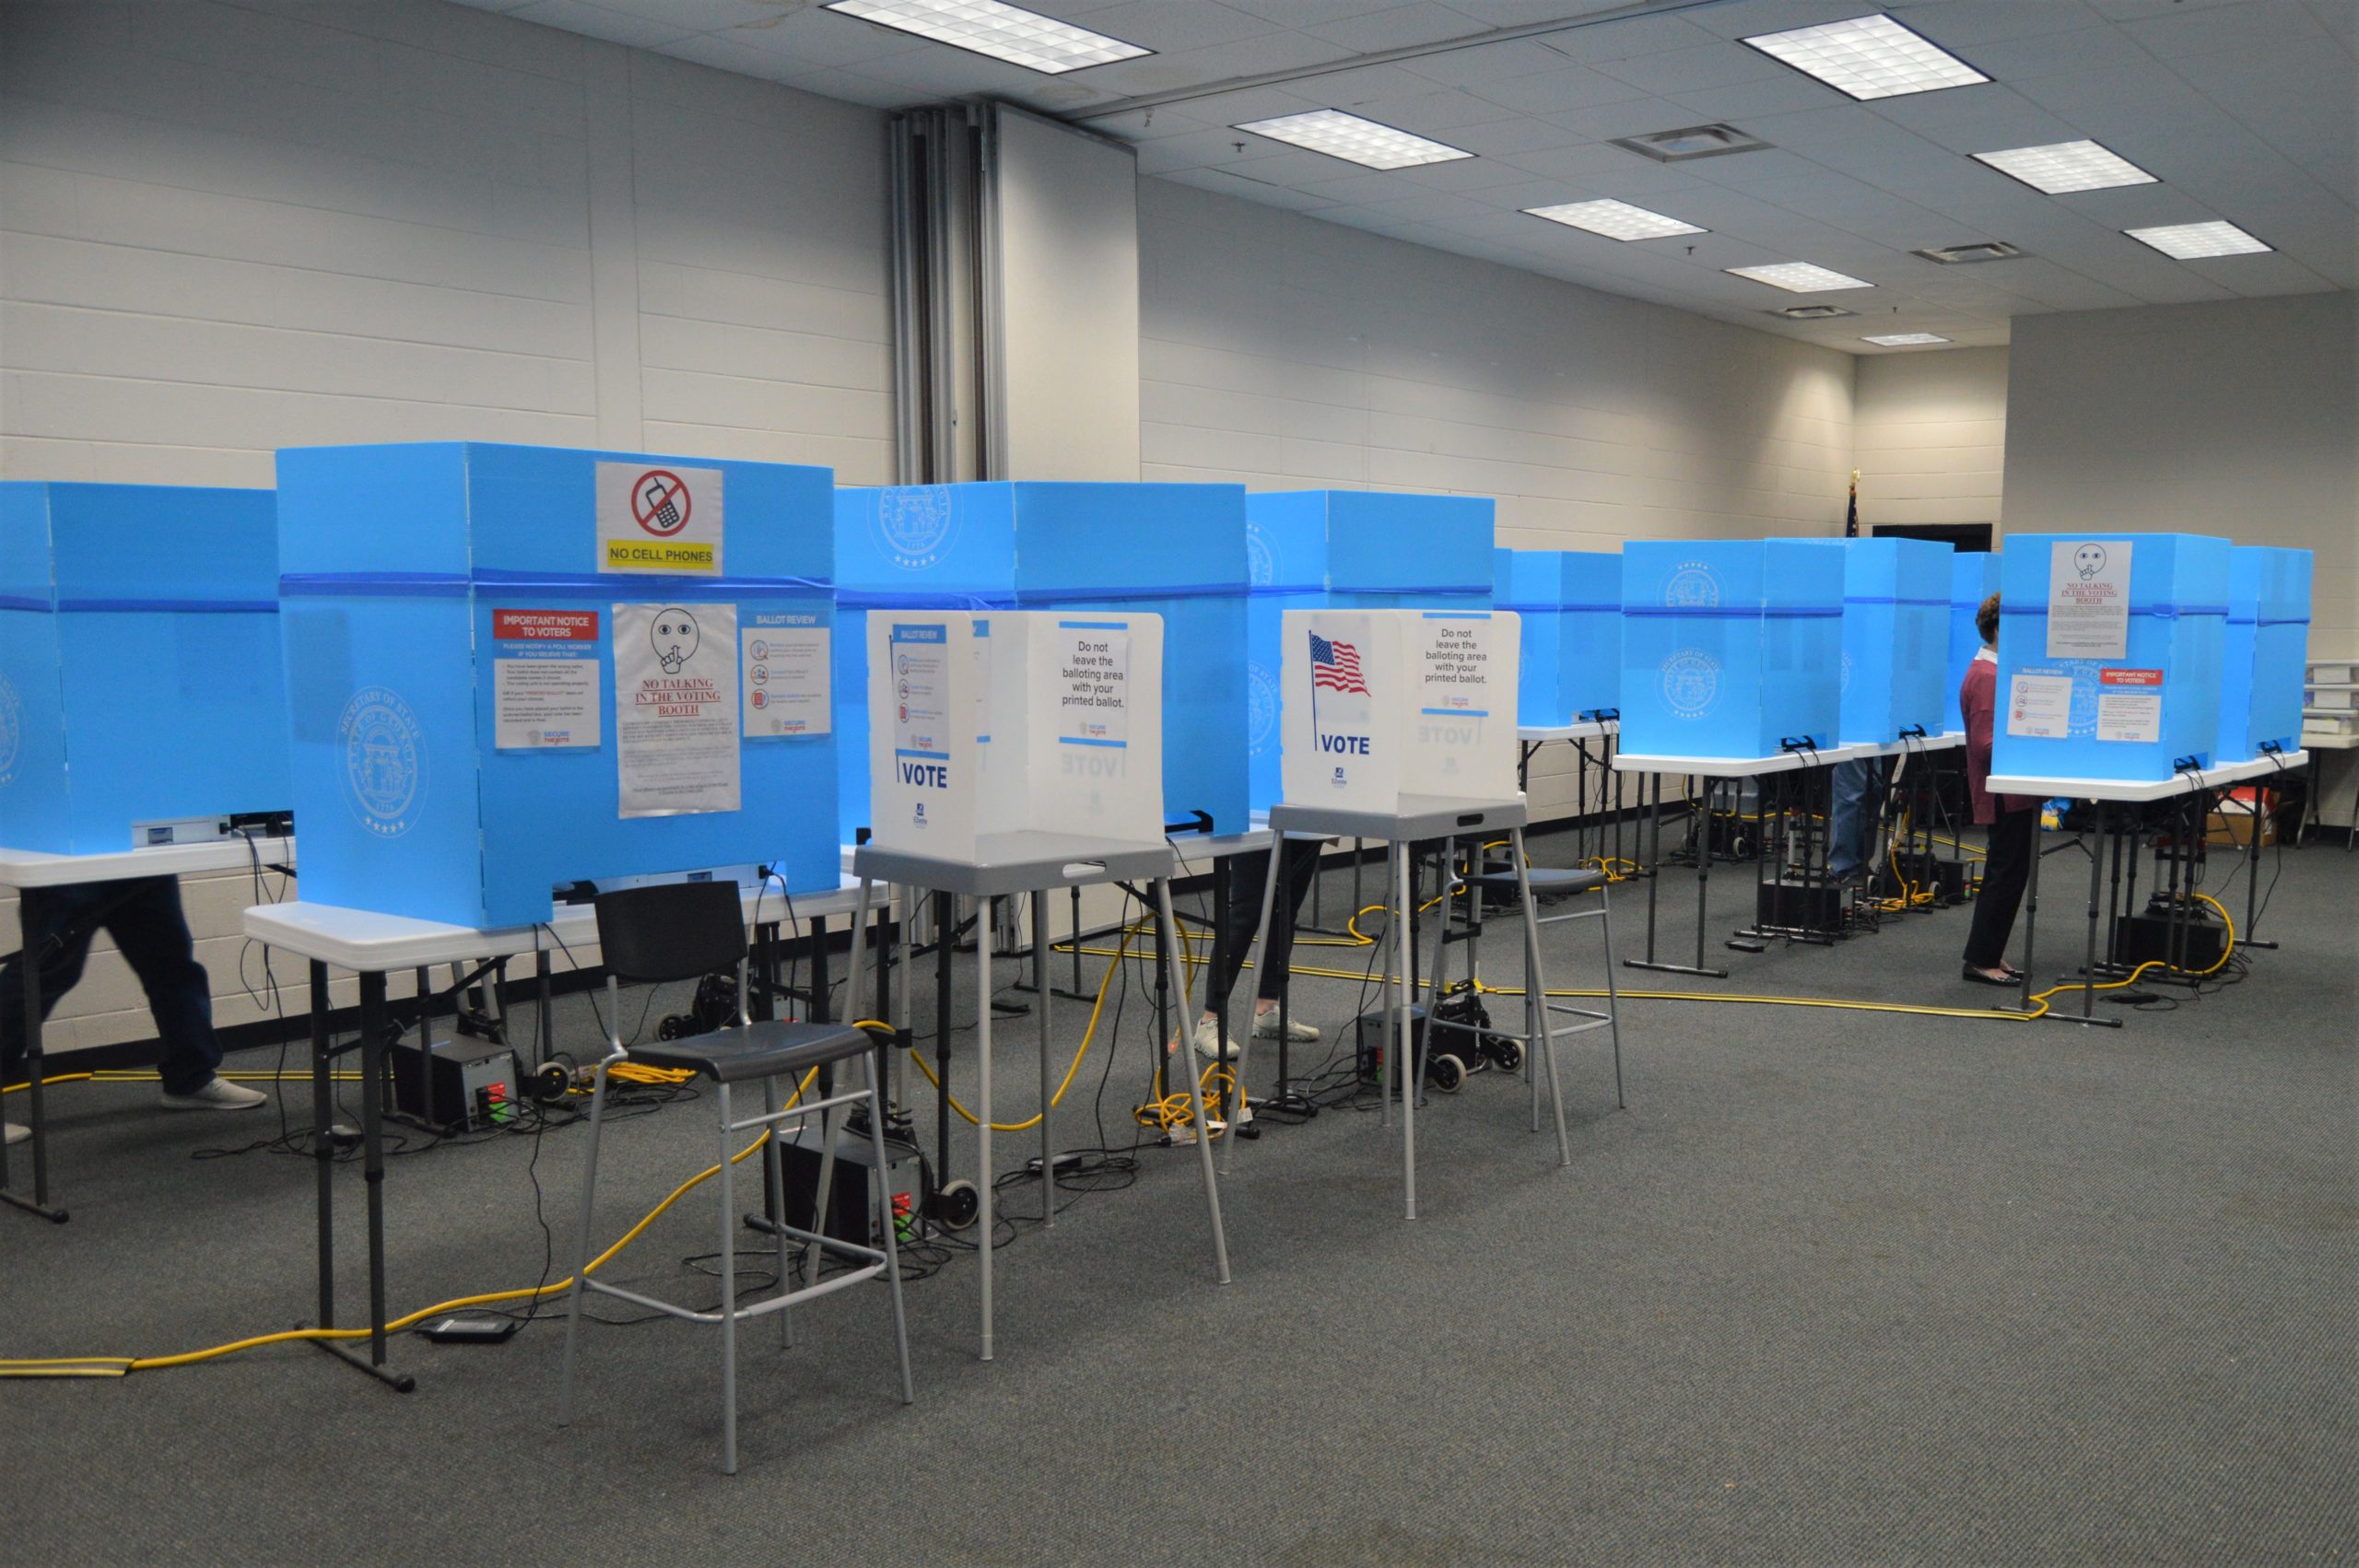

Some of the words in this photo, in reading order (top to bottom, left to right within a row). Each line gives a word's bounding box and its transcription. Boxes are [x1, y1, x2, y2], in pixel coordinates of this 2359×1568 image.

[610, 548, 628, 559] NO
[632, 549, 663, 560] CELL
[665, 550, 713, 562] PHONES
[503, 615, 556, 626] IMPORTANT
[557, 616, 590, 626] NOTICE
[756, 615, 786, 625] BALLOT
[786, 615, 816, 625] REVIEW
[522, 626, 535, 637] TO
[537, 627, 571, 638] VOTERS
[1441, 628, 1454, 638] Do
[1457, 630, 1473, 638] not
[1078, 641, 1091, 652] Do
[1094, 643, 1109, 652] not
[1436, 639, 1460, 649] leave
[1462, 640, 1477, 649] the
[1073, 654, 1097, 666] leave
[1098, 656, 1113, 666] the
[1426, 650, 1464, 662] balloting
[1467, 653, 1487, 661] area
[1435, 662, 1454, 672] with
[1456, 664, 1477, 673] your
[1062, 667, 1101, 682] balloting
[1103, 673, 1123, 681] area
[1425, 673, 1457, 684] printed
[1459, 674, 1487, 685] ballot.
[643, 679, 660, 689] NO
[663, 678, 713, 688] TALKING
[1072, 682, 1091, 694] with
[1094, 685, 1113, 696] your
[636, 693, 647, 703] IN
[651, 692, 674, 702] THE
[676, 691, 721, 701] VOTING
[1062, 696, 1094, 708] printed
[1096, 696, 1124, 708] ballot.
[659, 705, 699, 716] BOOTH
[1321, 734, 1370, 755] VOTE
[903, 763, 947, 789] VOTE
